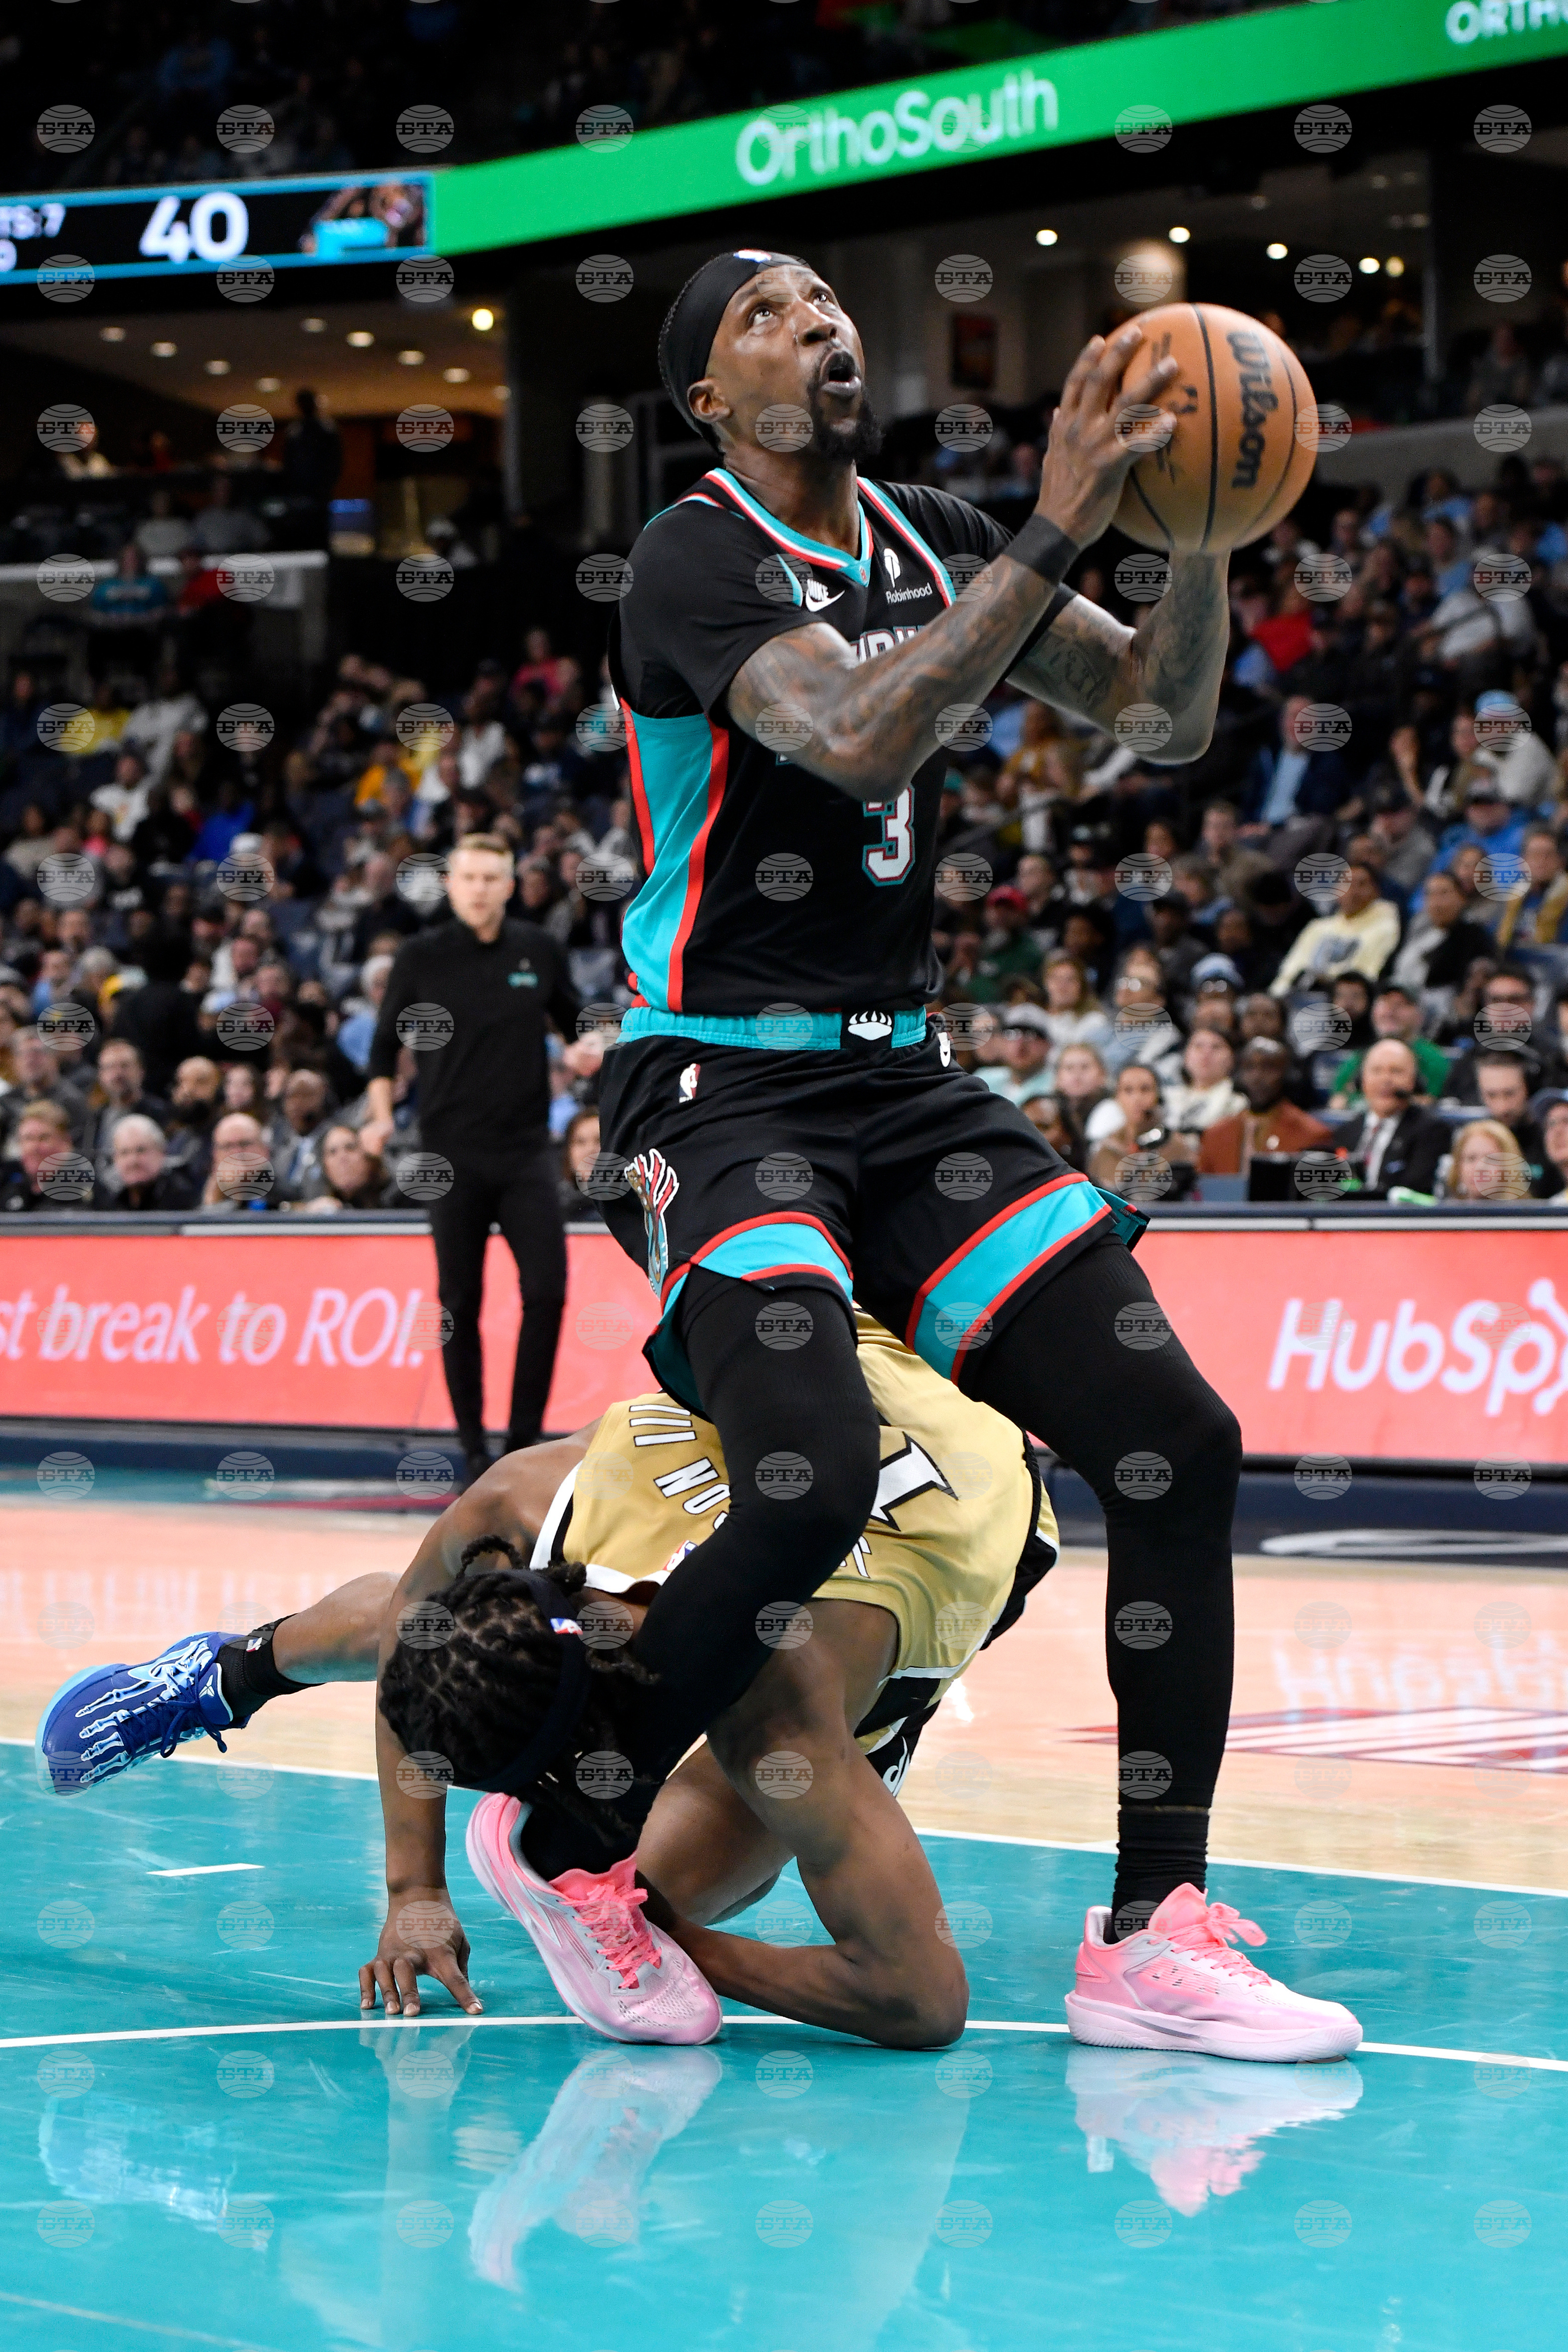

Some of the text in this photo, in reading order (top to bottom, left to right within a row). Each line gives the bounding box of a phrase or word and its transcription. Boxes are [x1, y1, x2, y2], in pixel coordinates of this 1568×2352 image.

[1445, 0, 1568, 45] ORTH
[736, 69, 1059, 186] OrthoSouth
[139, 191, 249, 264] 40
[1226, 331, 1279, 489] Wilson
[885, 582, 932, 605] Robinhood
[862, 783, 915, 887] 3
[38, 1283, 211, 1364] break
[219, 1290, 287, 1365] to
[294, 1287, 424, 1368] ROI.
[1268, 1289, 1568, 1417] HubSp
